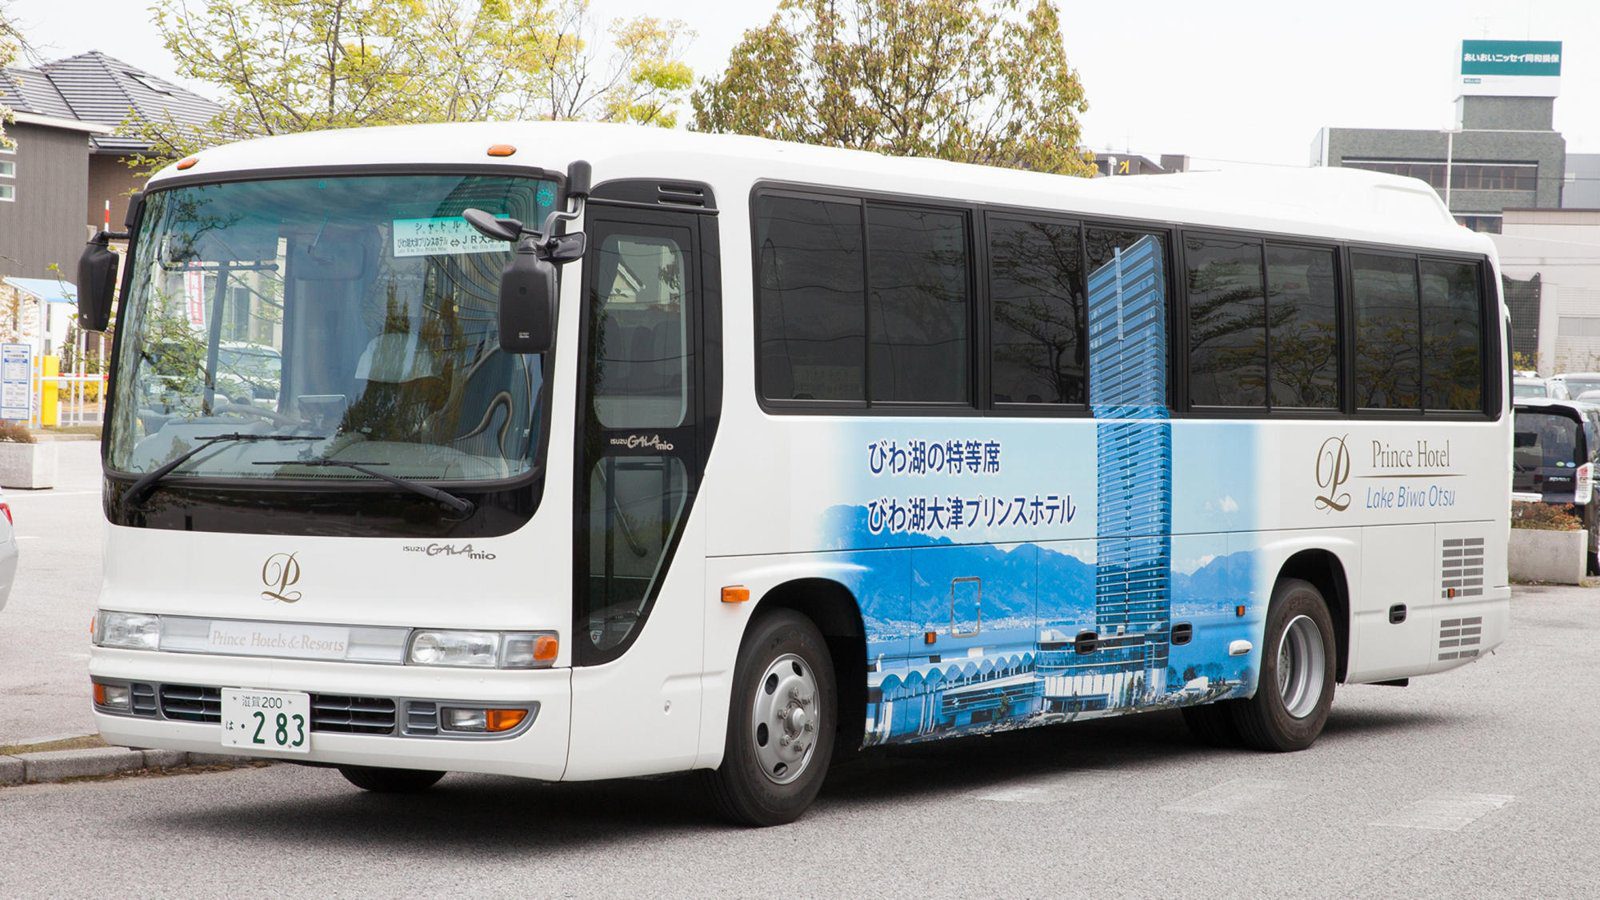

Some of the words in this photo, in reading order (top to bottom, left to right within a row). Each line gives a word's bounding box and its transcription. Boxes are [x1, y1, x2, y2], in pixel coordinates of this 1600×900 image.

[627, 434, 660, 449] GALA
[655, 440, 674, 451] mio
[1372, 440, 1413, 468] Prince
[1417, 439, 1450, 468] Hotel
[868, 440, 1001, 475] びわ湖の特等席
[1366, 486, 1394, 509] Lake
[1398, 486, 1426, 508] Biwa
[1429, 485, 1456, 507] Otsu
[868, 494, 1077, 533] びわ湖大津プリンスホテル
[426, 543, 474, 557] GALA
[469, 550, 497, 560] mio
[212, 630, 247, 647] Prince
[250, 631, 287, 649] Hotels
[287, 638, 300, 649] &
[301, 634, 345, 652] Resorts
